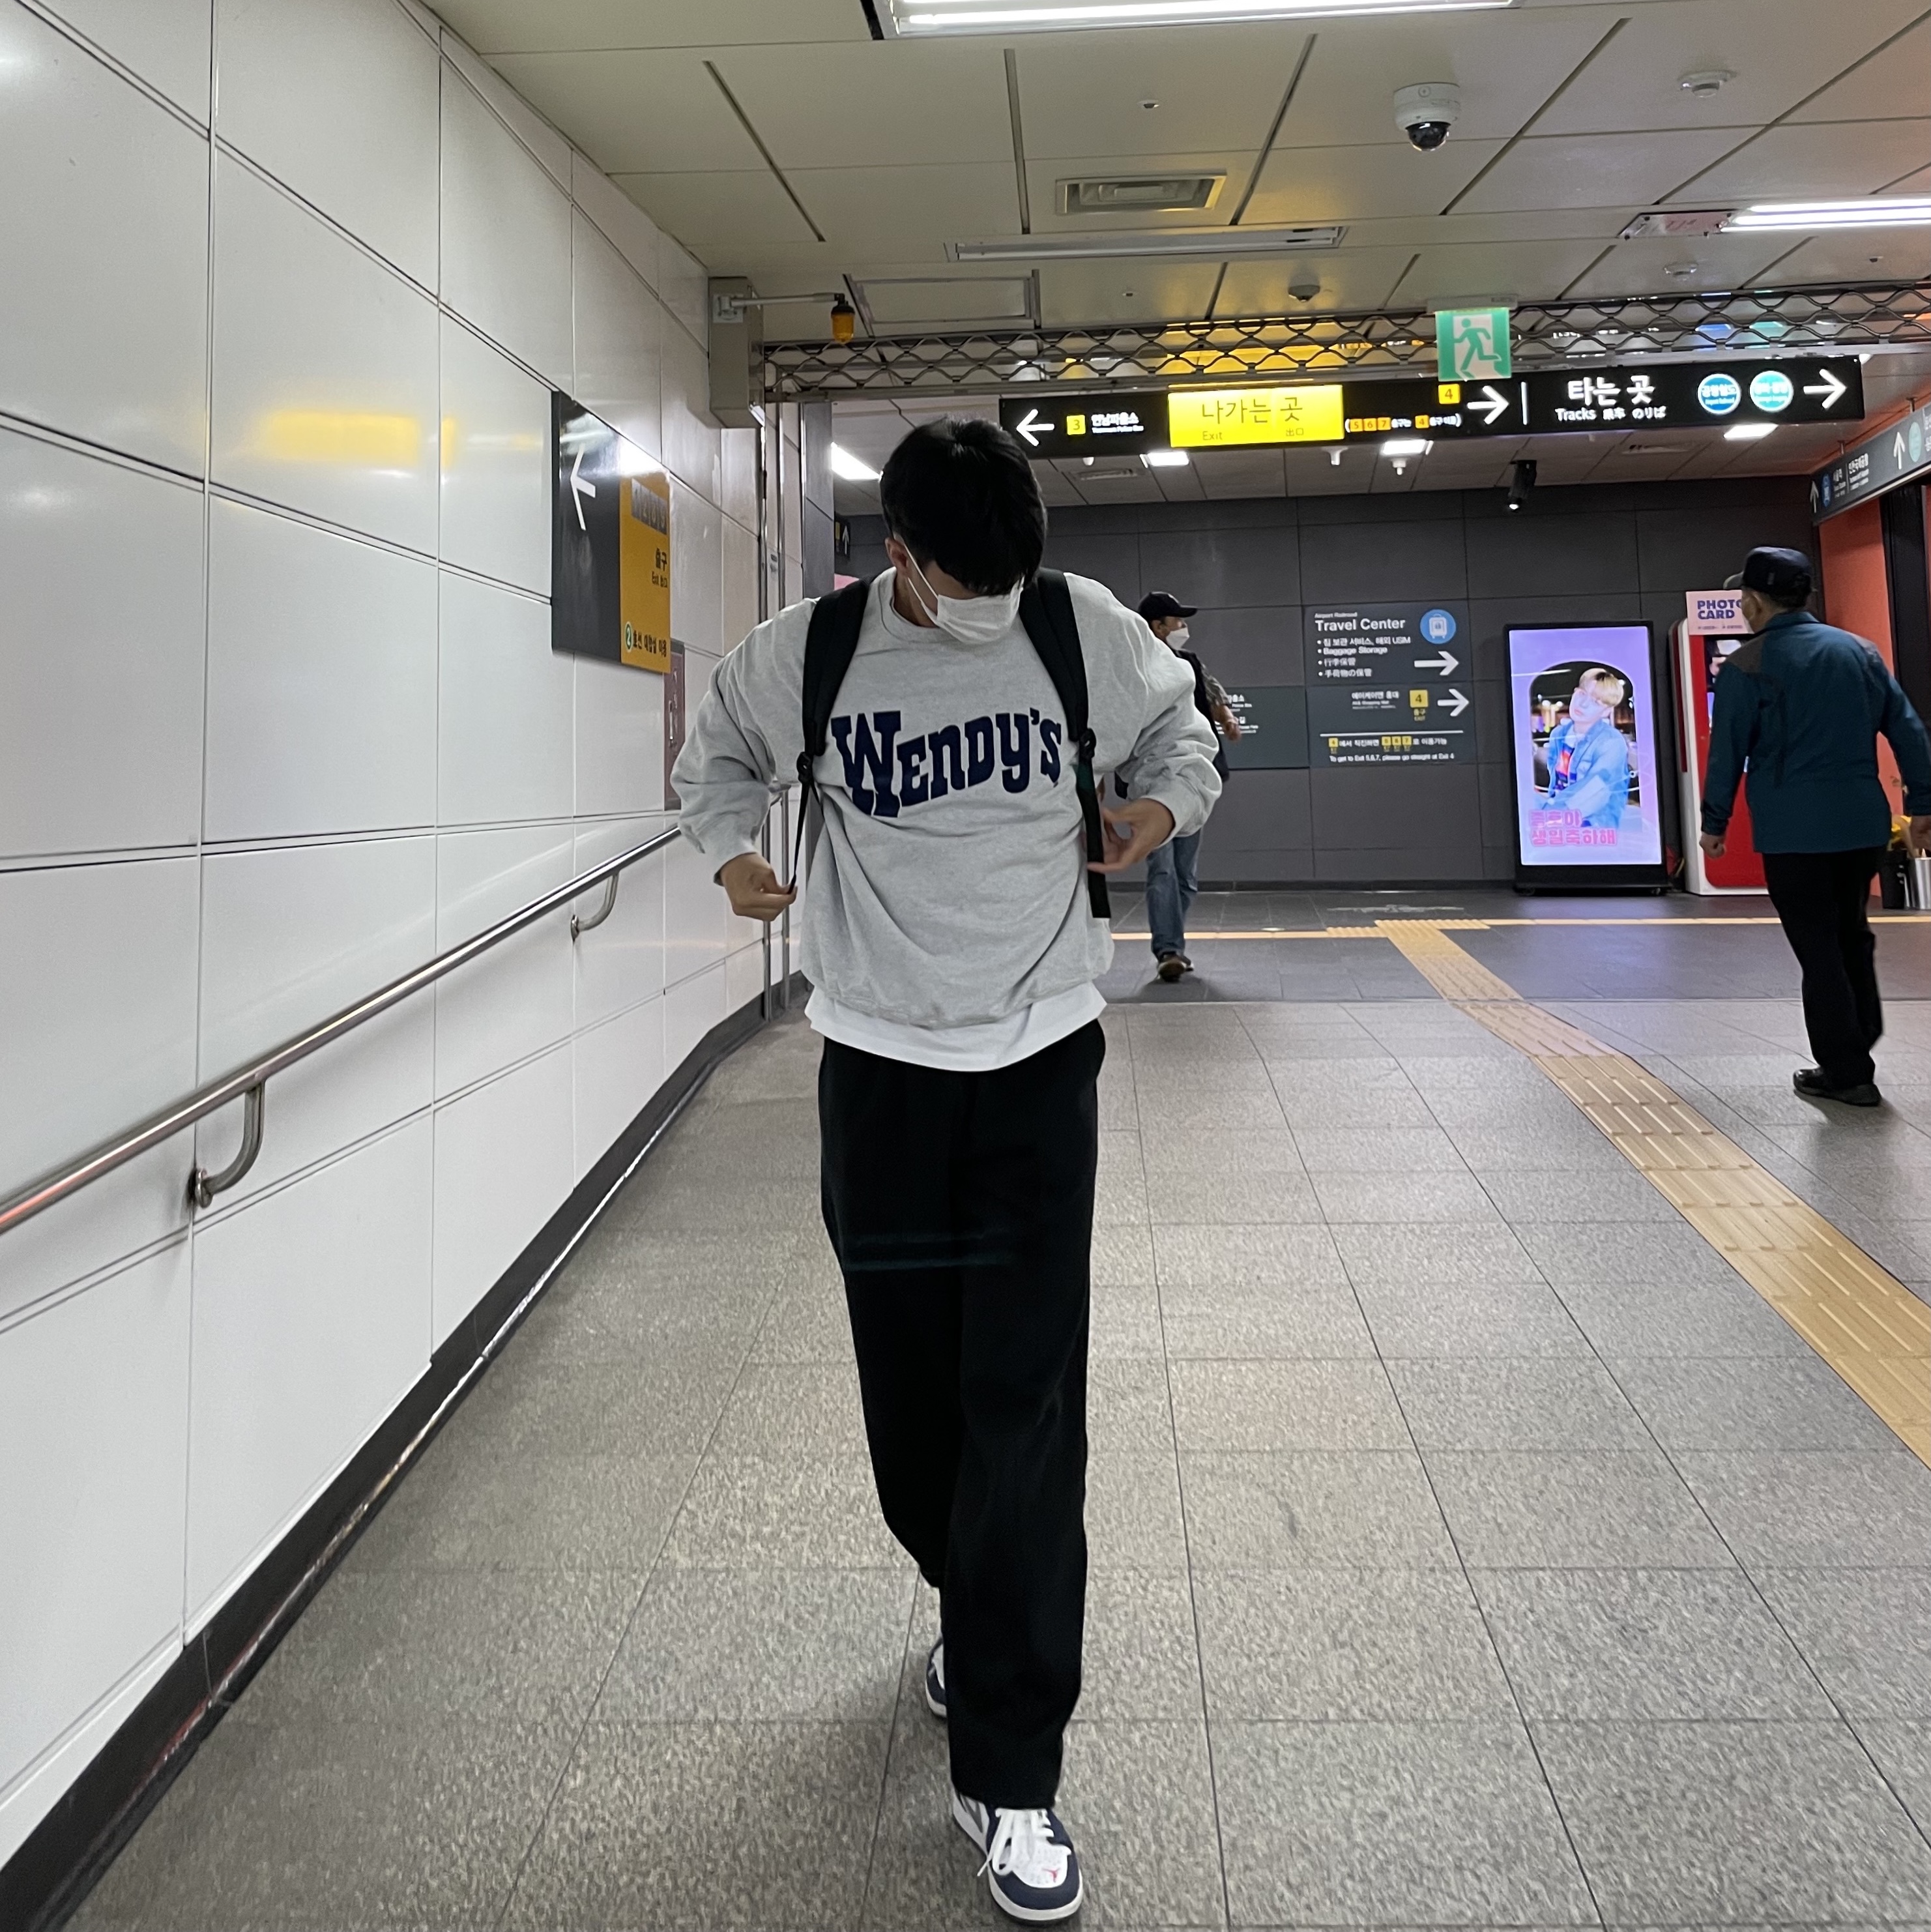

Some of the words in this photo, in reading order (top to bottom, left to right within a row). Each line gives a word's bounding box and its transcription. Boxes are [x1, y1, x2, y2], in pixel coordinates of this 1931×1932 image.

[1444, 388, 1453, 400] 4
[1567, 377, 1621, 406] 타는
[1627, 375, 1655, 405] 곳
[1202, 399, 1271, 424] 나가는
[1280, 397, 1303, 422] 곳
[1555, 407, 1596, 421] Tracks
[1632, 405, 1666, 420] のりば
[1072, 419, 1081, 431] 3
[1202, 430, 1223, 441] Exit
[1285, 428, 1304, 437] 出口
[1697, 609, 1735, 619] CARD
[1314, 619, 1357, 631] Travel
[1360, 618, 1406, 630] Center
[1323, 647, 1357, 656] Baggage
[1358, 646, 1388, 654] Storage
[1415, 694, 1423, 703] 4
[1532, 828, 1616, 845] 생일축하해
